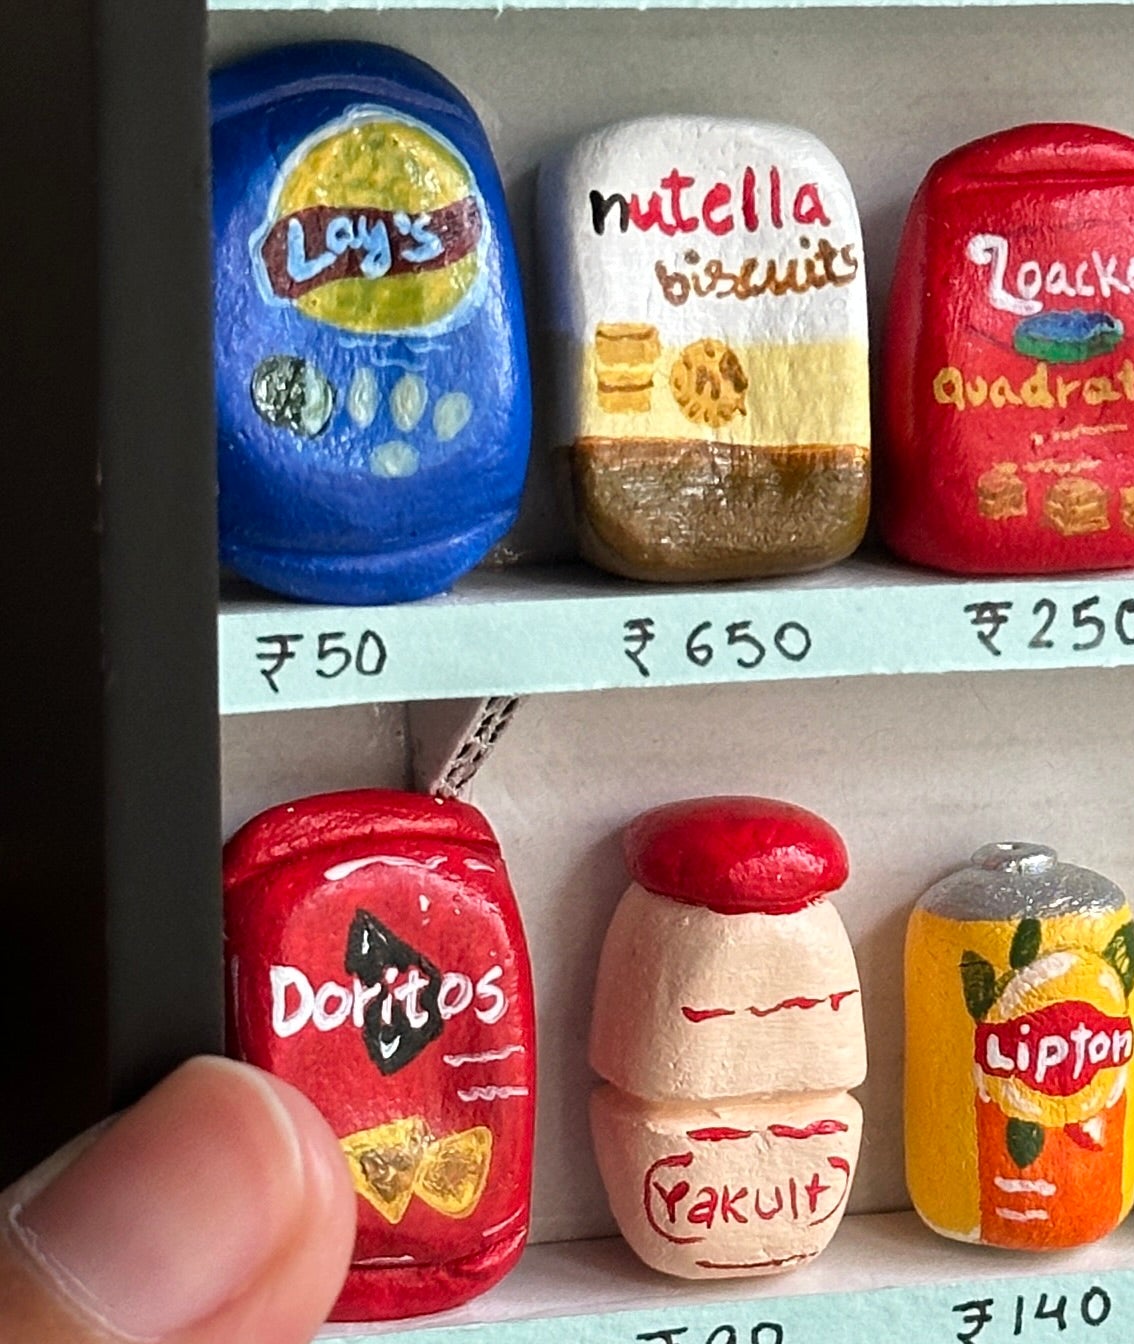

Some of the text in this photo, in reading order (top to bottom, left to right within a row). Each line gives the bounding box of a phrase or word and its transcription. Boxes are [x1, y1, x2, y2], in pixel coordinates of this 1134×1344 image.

[589, 166, 832, 236] nutella
[287, 215, 444, 284] Lay's
[654, 236, 858, 307] biscuits
[270, 964, 512, 1037] Doritos
[986, 1026, 1134, 1084] Lipton
[654, 1178, 832, 1231] Yakult
